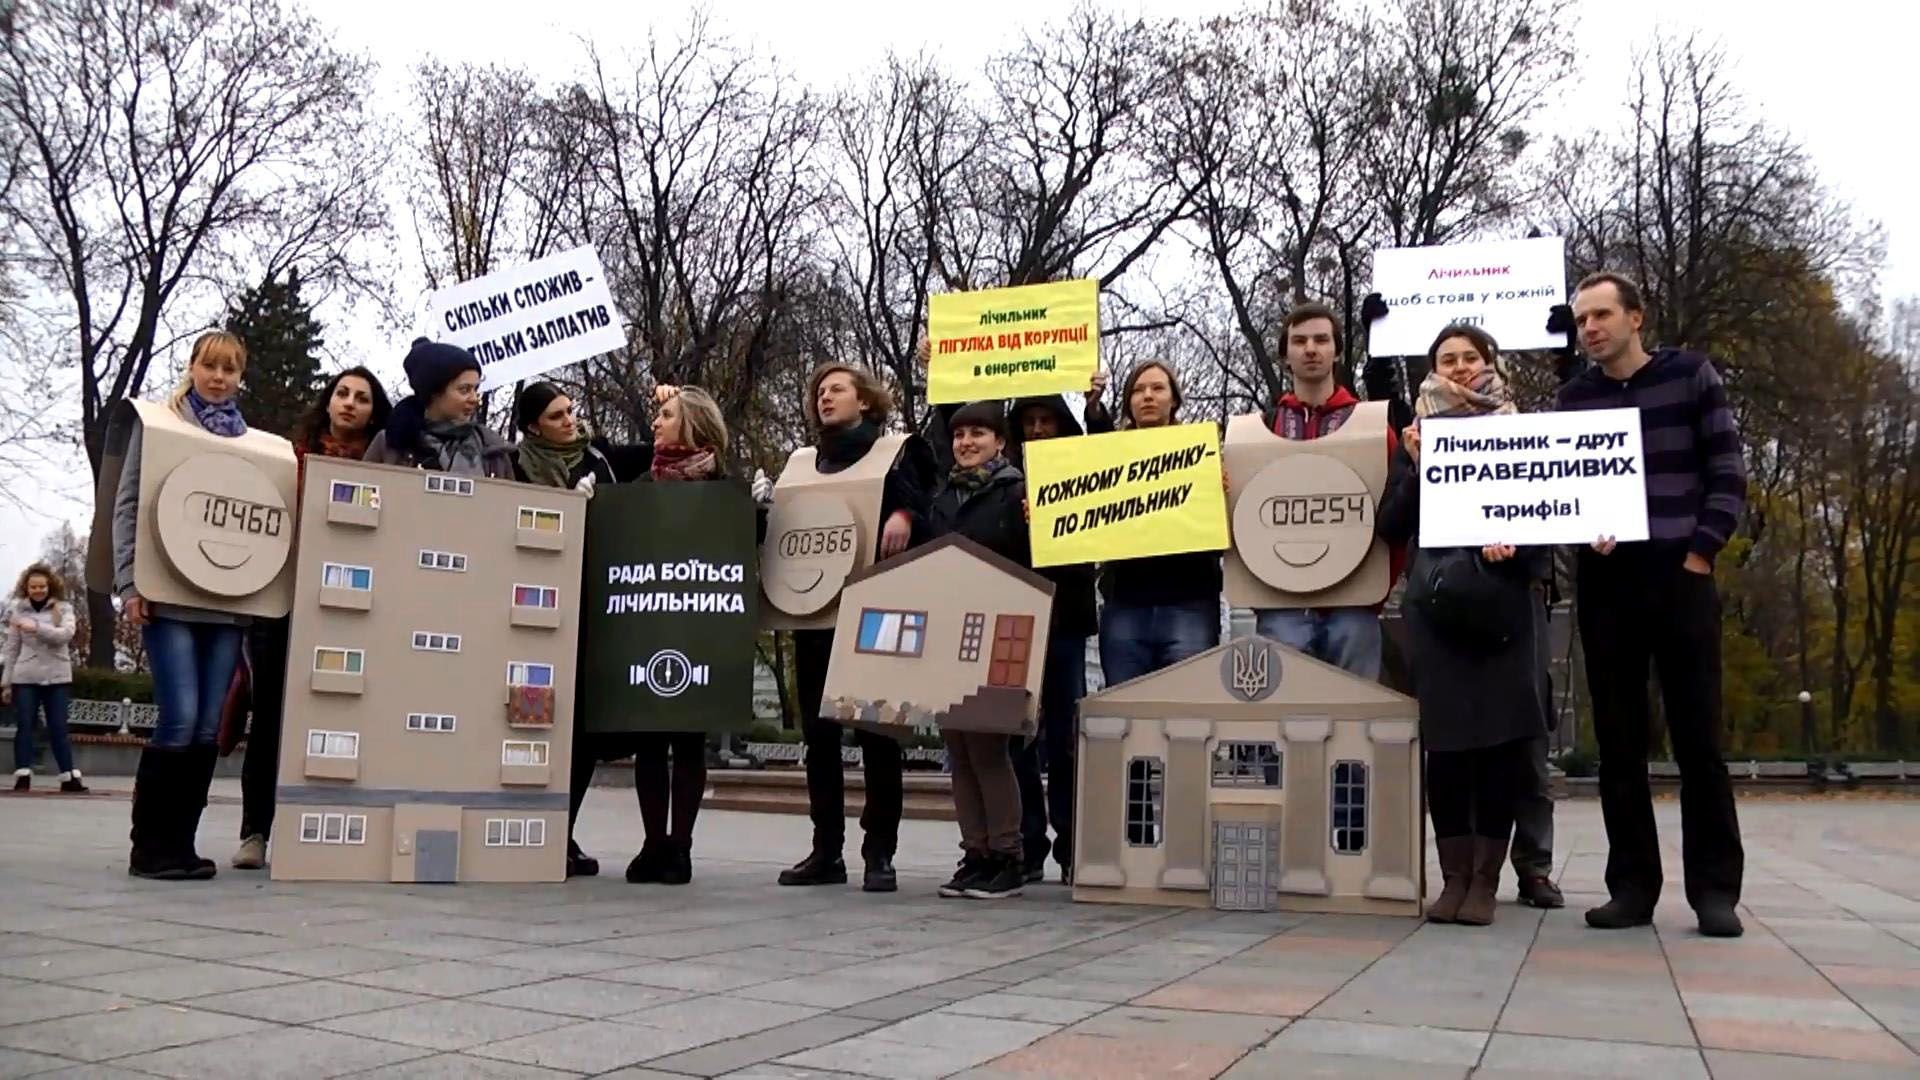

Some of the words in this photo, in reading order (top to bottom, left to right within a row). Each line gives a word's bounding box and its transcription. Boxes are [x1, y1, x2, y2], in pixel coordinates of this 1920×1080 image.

[1428, 265, 1511, 280] Лічильник
[445, 292, 512, 332] СКІЛЬКИ
[514, 270, 583, 308] СПОЖИВ
[1427, 293, 1475, 304] стояв
[1481, 290, 1490, 303] у
[1496, 284, 1555, 299] кожній
[526, 304, 610, 350] ЗАПЛАТИВ
[980, 307, 1048, 326] лічильник
[1449, 314, 1484, 326] хаті
[939, 335, 994, 354] ПІГУЛКА
[998, 333, 1022, 350] ВІД
[1024, 323, 1089, 346] КОРУПЦІЇ
[974, 365, 981, 377] в
[985, 355, 1056, 376] енергетиці
[1433, 435, 1550, 453] Лічильник
[1576, 431, 1628, 449] друг
[1425, 457, 1637, 484] СПРАВЕДЛИВИХ
[1036, 465, 1124, 507] КОЖНОМУ
[203, 498, 281, 536] 10460
[1052, 513, 1079, 538] ПО
[1080, 483, 1193, 532] ЛІЧИЛЬНИКУ
[1273, 497, 1364, 525] 00254
[1481, 498, 1580, 521] тарифів!
[787, 529, 852, 556] 00366
[608, 563, 656, 584] РАДА
[661, 559, 744, 582] БОЇТЬСЯ
[606, 592, 745, 614] ЛІЧИЛЬНИКА
